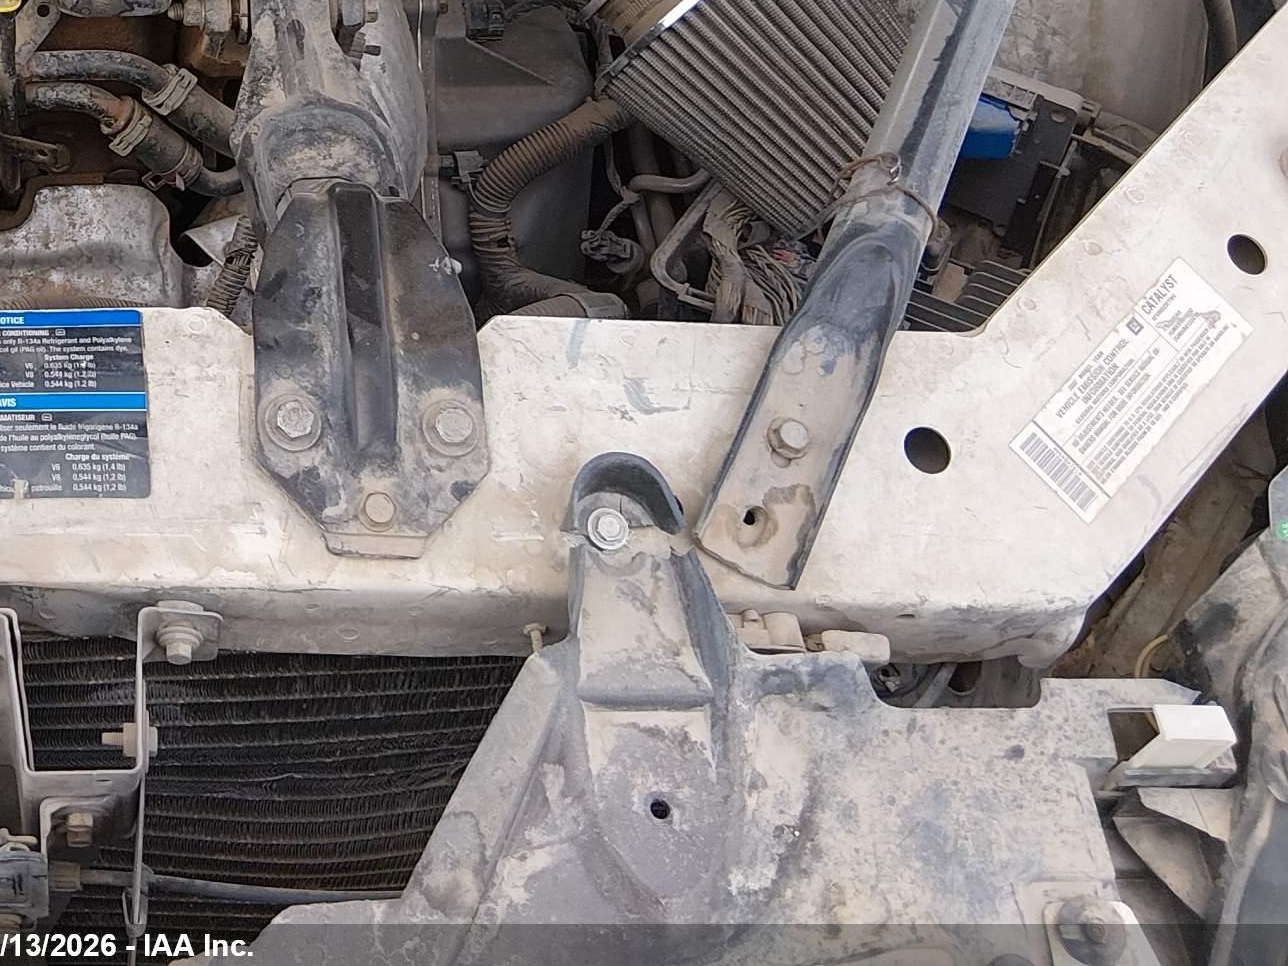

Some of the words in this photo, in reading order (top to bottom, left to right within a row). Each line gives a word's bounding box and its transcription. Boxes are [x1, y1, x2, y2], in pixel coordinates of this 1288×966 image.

[1139, 273, 1179, 315] CATALYST
[42, 337, 77, 345] Refrigerant
[70, 353, 93, 361] Charge
[1055, 391, 1080, 419] VEHICLE
[1077, 362, 1106, 394] EMISSION
[1101, 337, 1128, 366] CONTROL
[64, 380, 72, 388] kg
[1080, 361, 1119, 405] INFORMATION
[65, 453, 89, 461] Charge
[92, 463, 100, 471] kg
[93, 473, 101, 481] kg
[93, 484, 101, 492] kg
